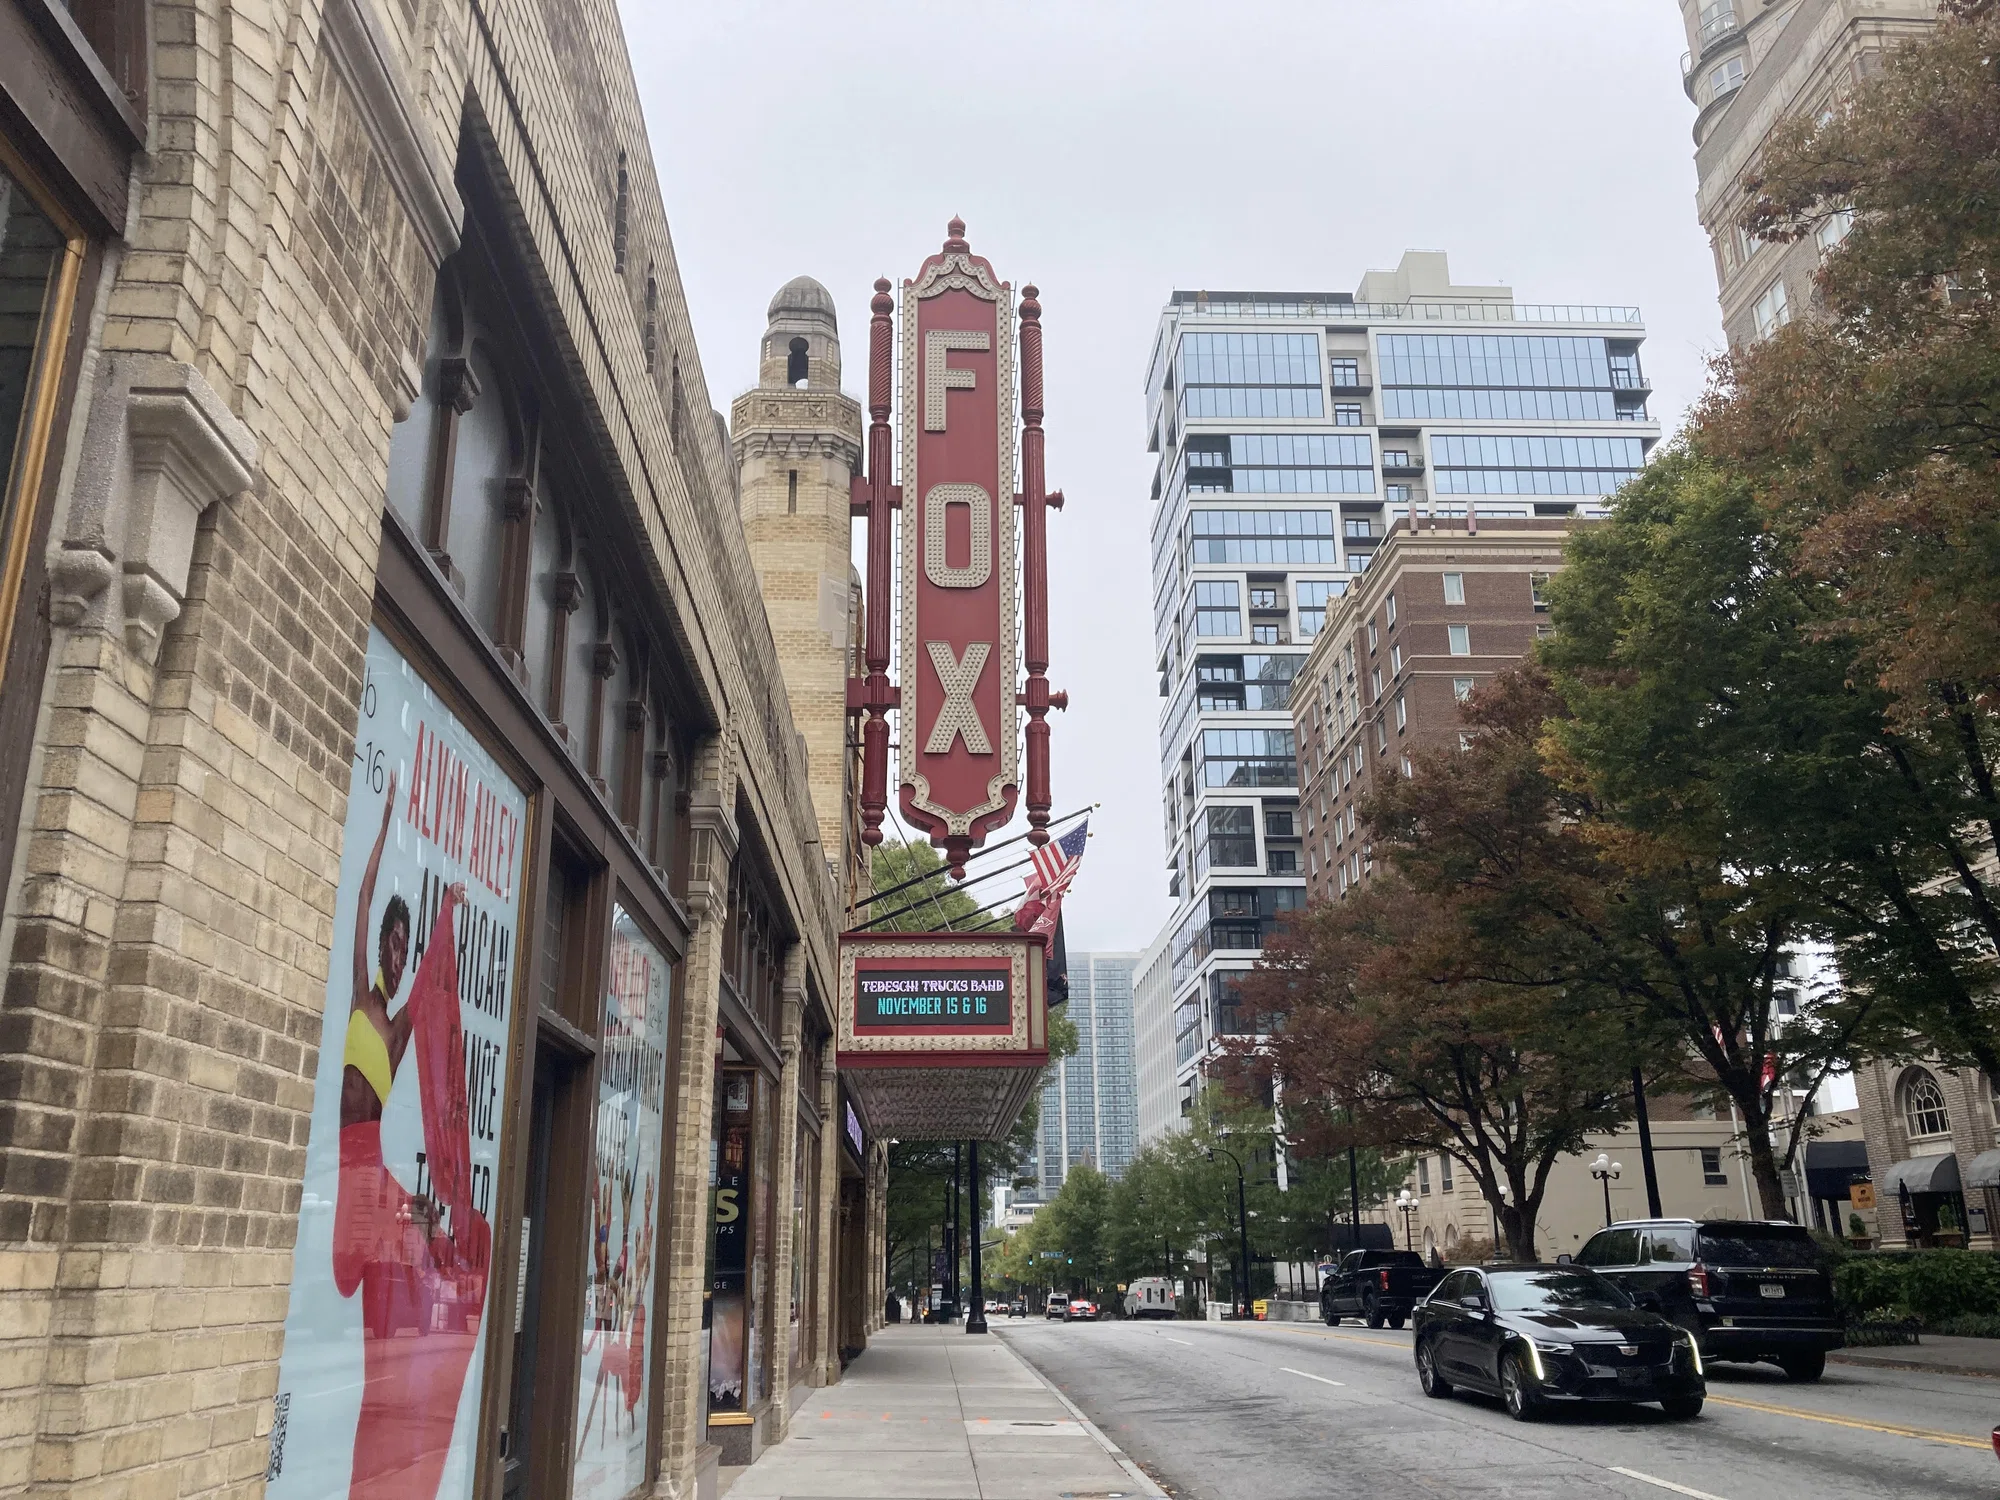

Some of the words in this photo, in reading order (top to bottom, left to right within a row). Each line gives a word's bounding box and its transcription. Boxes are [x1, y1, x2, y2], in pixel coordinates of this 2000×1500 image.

[924, 330, 993, 754] FOX
[407, 720, 469, 866] ALVIN
[469, 780, 518, 905] AILEY
[412, 867, 509, 1022] ARICAN
[861, 981, 918, 992] TEDESCHI
[922, 980, 968, 992] TRUCKS
[970, 980, 1004, 992] BAND
[877, 997, 941, 1015] NOVEMBER
[946, 997, 958, 1014] 15
[962, 997, 971, 1014] &
[975, 997, 987, 1014] 16
[453, 1026, 500, 1141] NCE
[601, 1010, 641, 1101] MERICAN
[597, 1099, 628, 1182] HEATER
[716, 1189, 739, 1223] S
